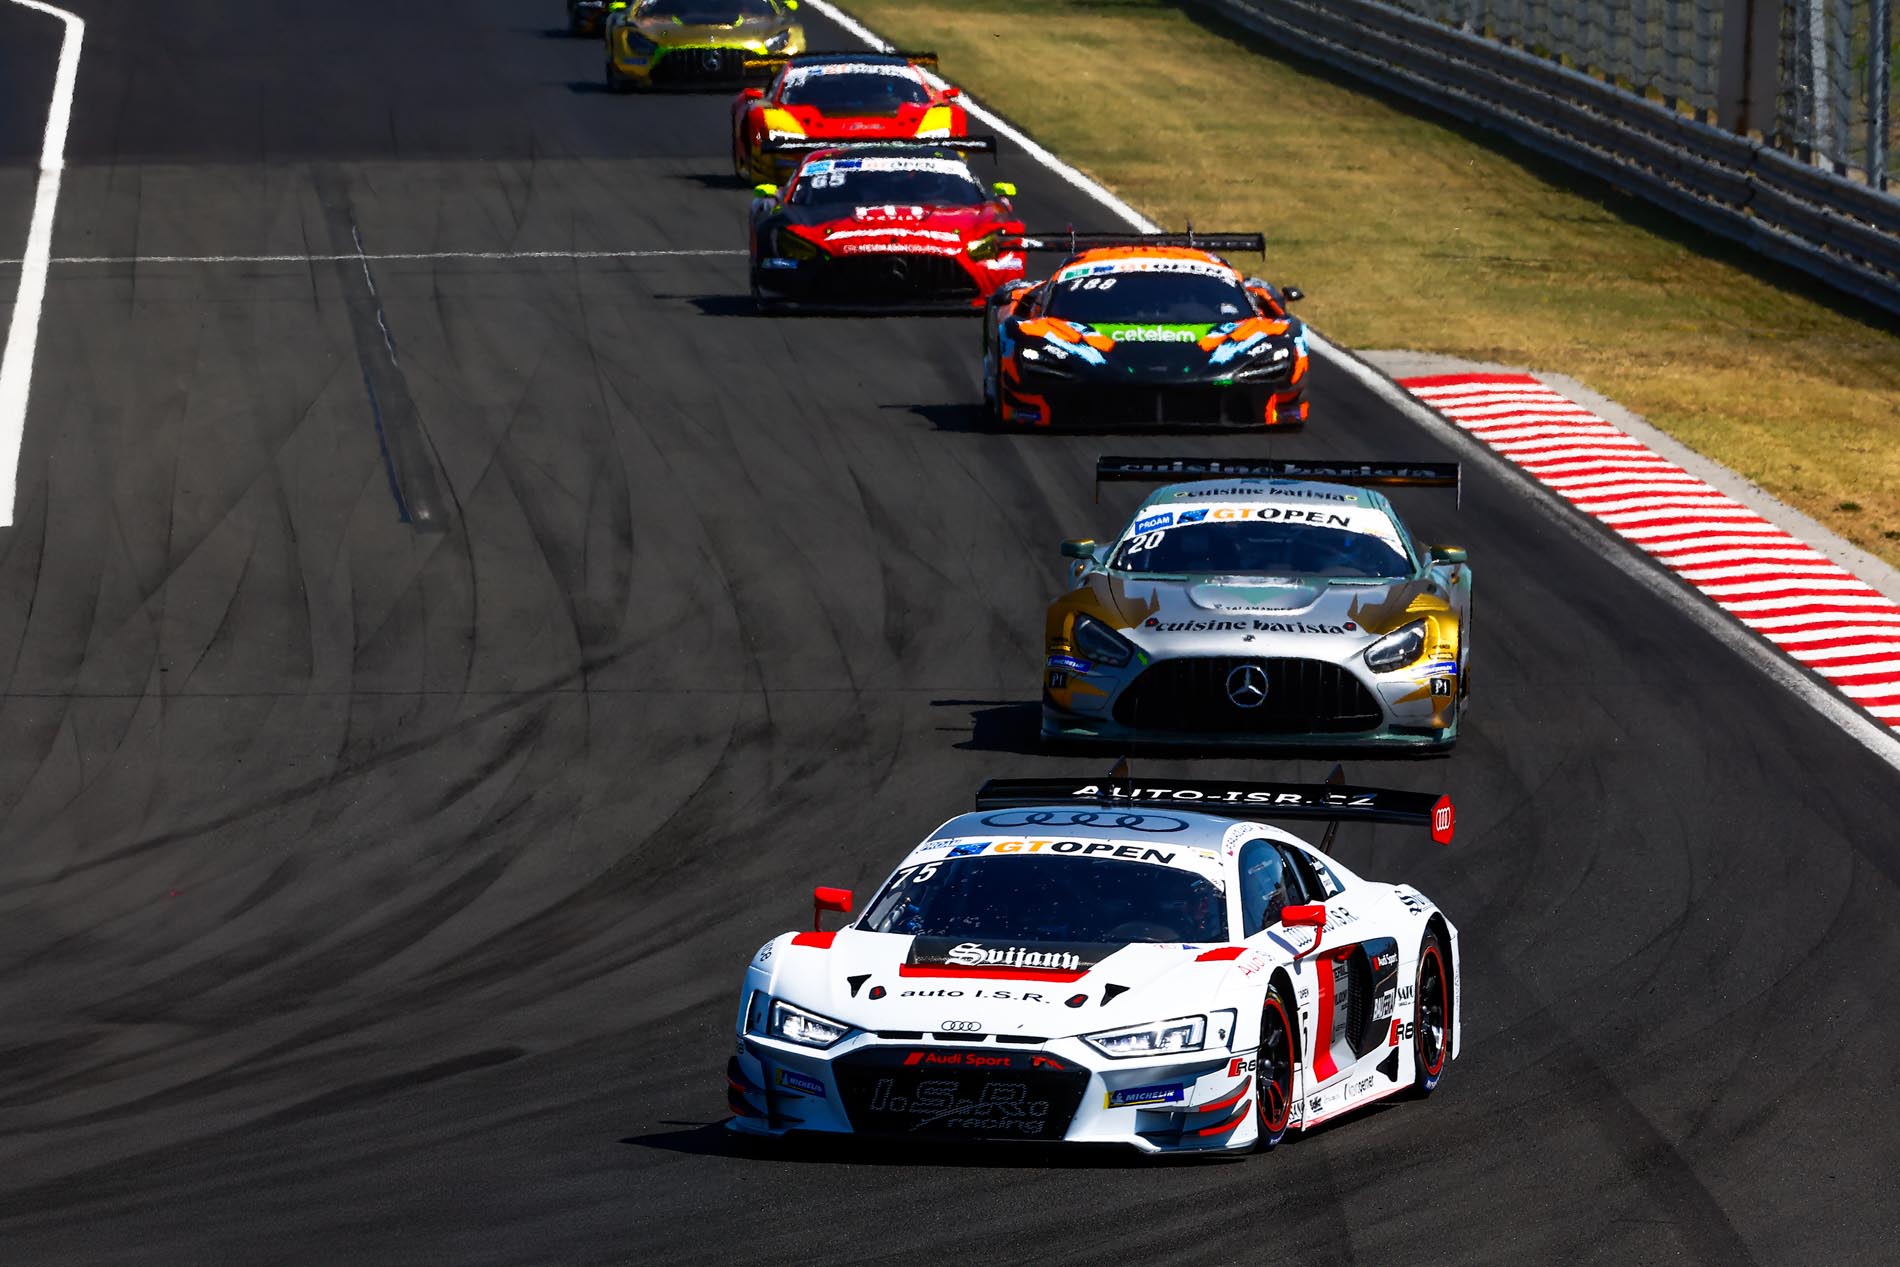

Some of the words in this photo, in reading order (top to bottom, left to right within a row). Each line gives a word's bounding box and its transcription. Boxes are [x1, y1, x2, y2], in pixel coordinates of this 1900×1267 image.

[811, 172, 846, 189] 65
[1112, 325, 1196, 342] cetelem
[1269, 487, 1346, 502] barista
[1138, 516, 1170, 530] PROAM
[1128, 531, 1165, 555] 20
[1155, 619, 1247, 632] cuisine
[1253, 619, 1345, 635] barista
[891, 861, 943, 890] 75
[901, 989, 964, 998] auto
[975, 990, 1050, 1004] I.S.R.
[925, 1053, 961, 1065] Audi
[965, 1054, 1011, 1067] Sport
[1126, 1090, 1175, 1102] MICHELIN
